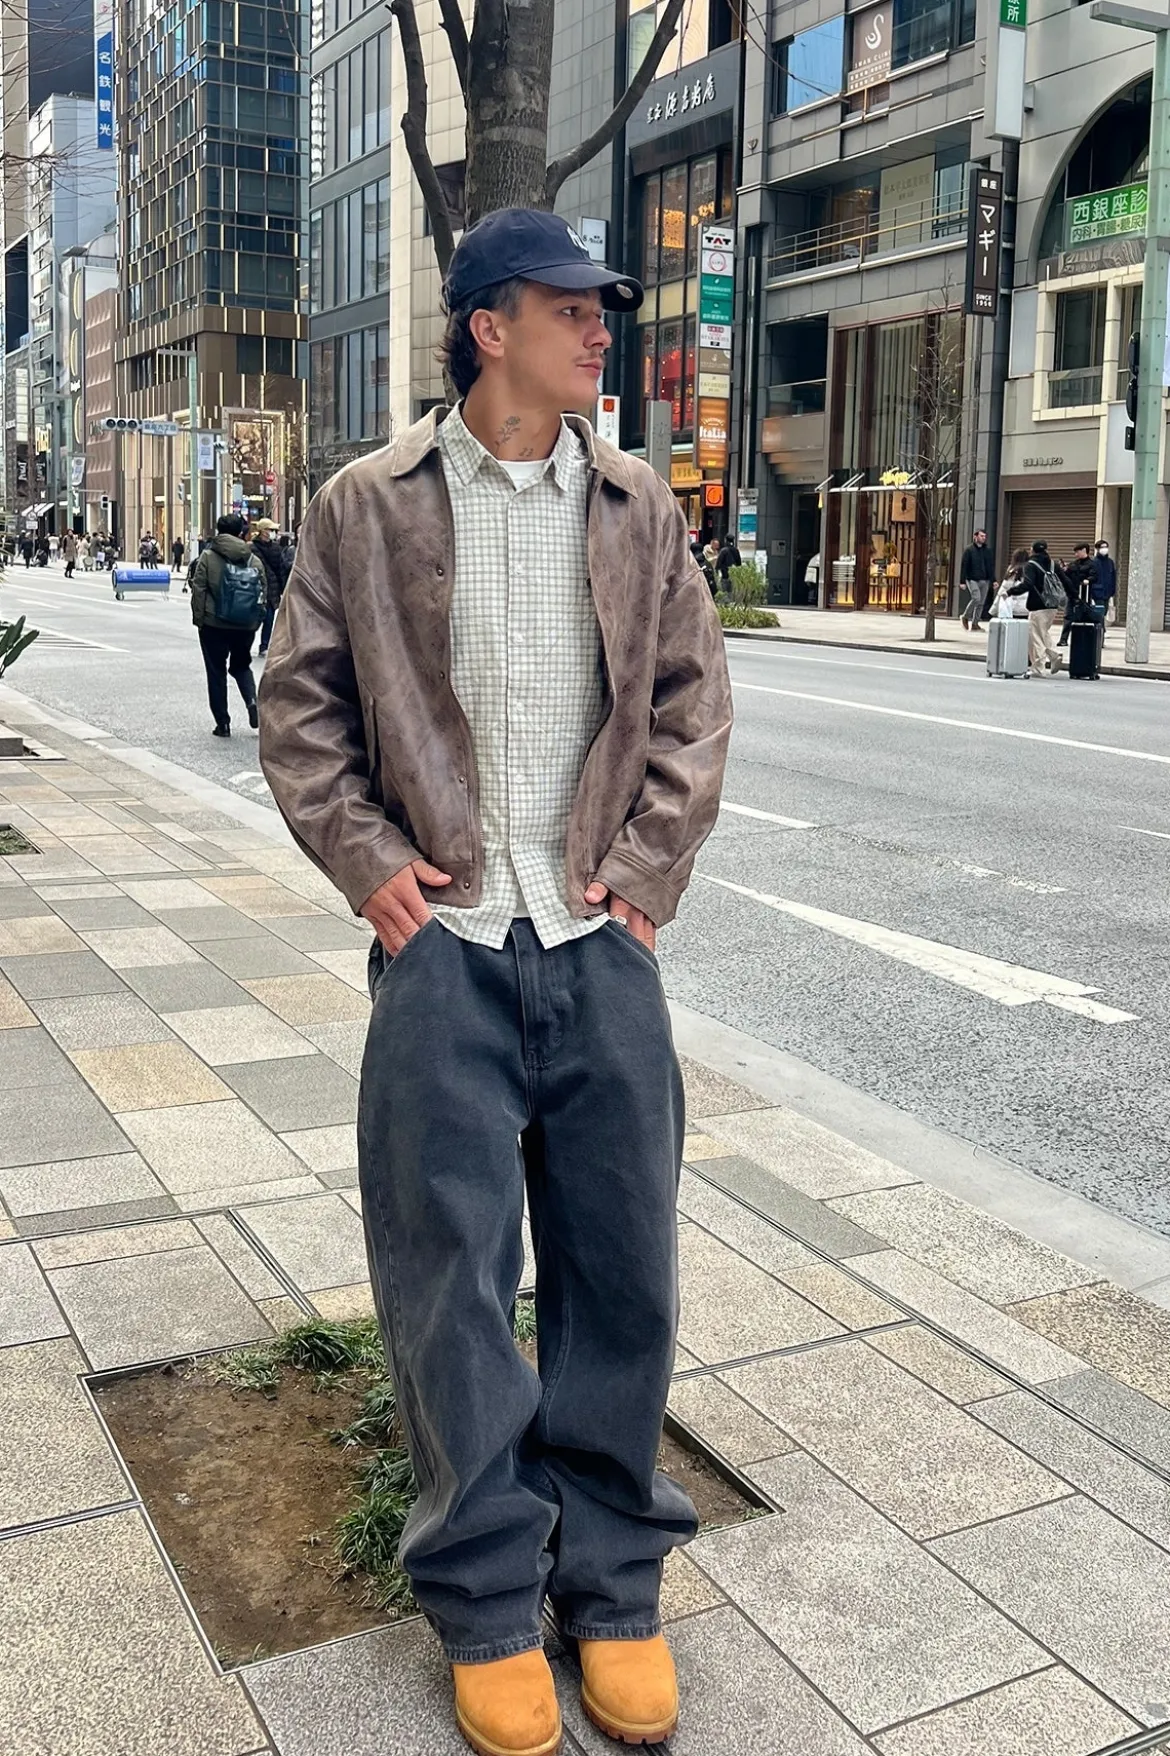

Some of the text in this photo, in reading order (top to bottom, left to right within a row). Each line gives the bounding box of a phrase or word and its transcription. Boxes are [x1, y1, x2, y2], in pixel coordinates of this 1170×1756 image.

[1007, 0, 1020, 22] 所
[99, 51, 111, 136] 名鉄観光
[1073, 188, 1147, 225] 西銀座診
[979, 204, 996, 276] マギー
[1073, 213, 1147, 241] 内科・胃腸・糖尿
